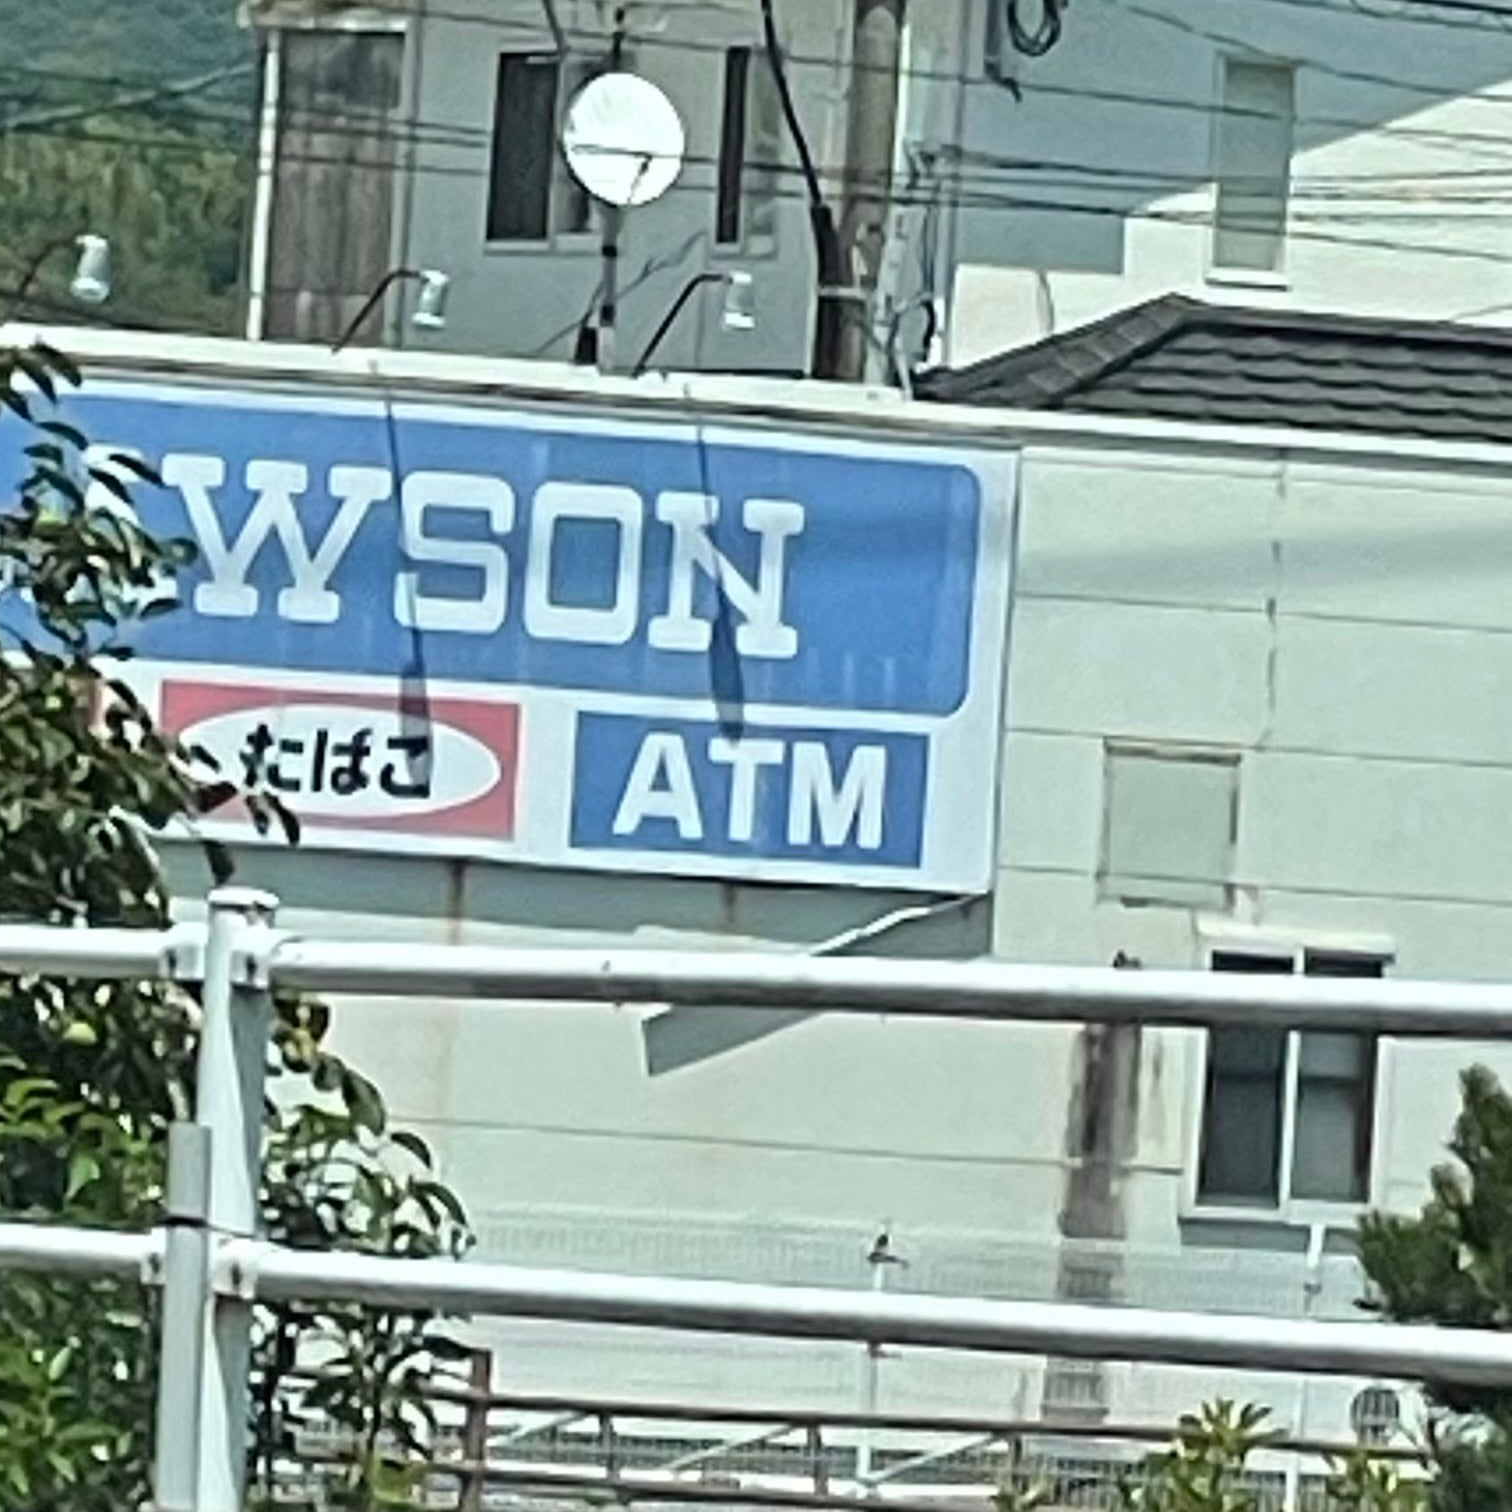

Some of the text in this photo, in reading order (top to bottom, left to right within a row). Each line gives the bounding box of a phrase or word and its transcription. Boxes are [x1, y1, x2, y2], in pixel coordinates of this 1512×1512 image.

[239, 724, 431, 798] たばこ
[611, 733, 886, 850] ATM
